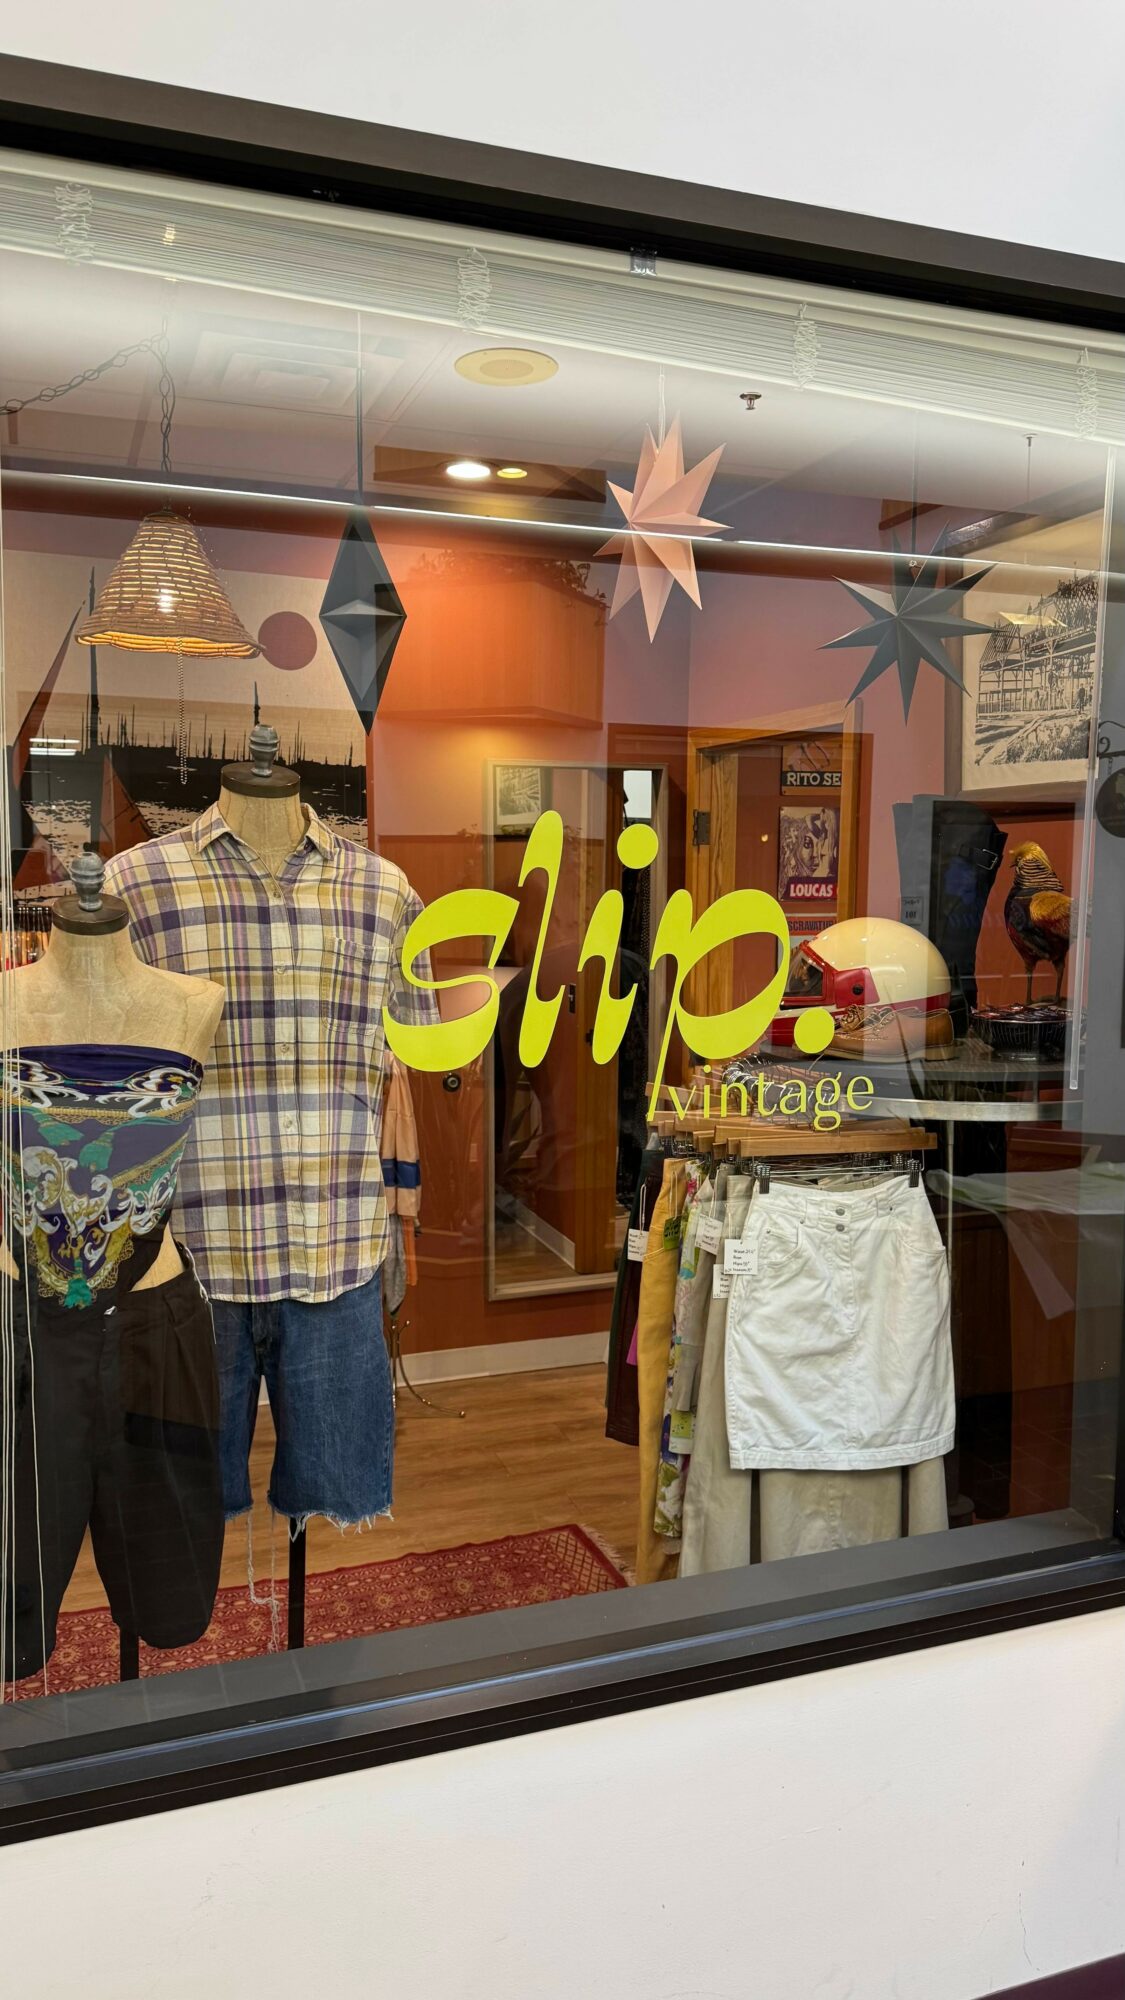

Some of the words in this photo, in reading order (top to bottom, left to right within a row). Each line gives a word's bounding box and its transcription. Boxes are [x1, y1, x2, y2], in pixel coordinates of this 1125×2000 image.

[787, 772, 820, 786] RITO
[823, 772, 841, 786] SE
[790, 883, 834, 897] LOUCAS
[668, 1065, 874, 1131] vintage
